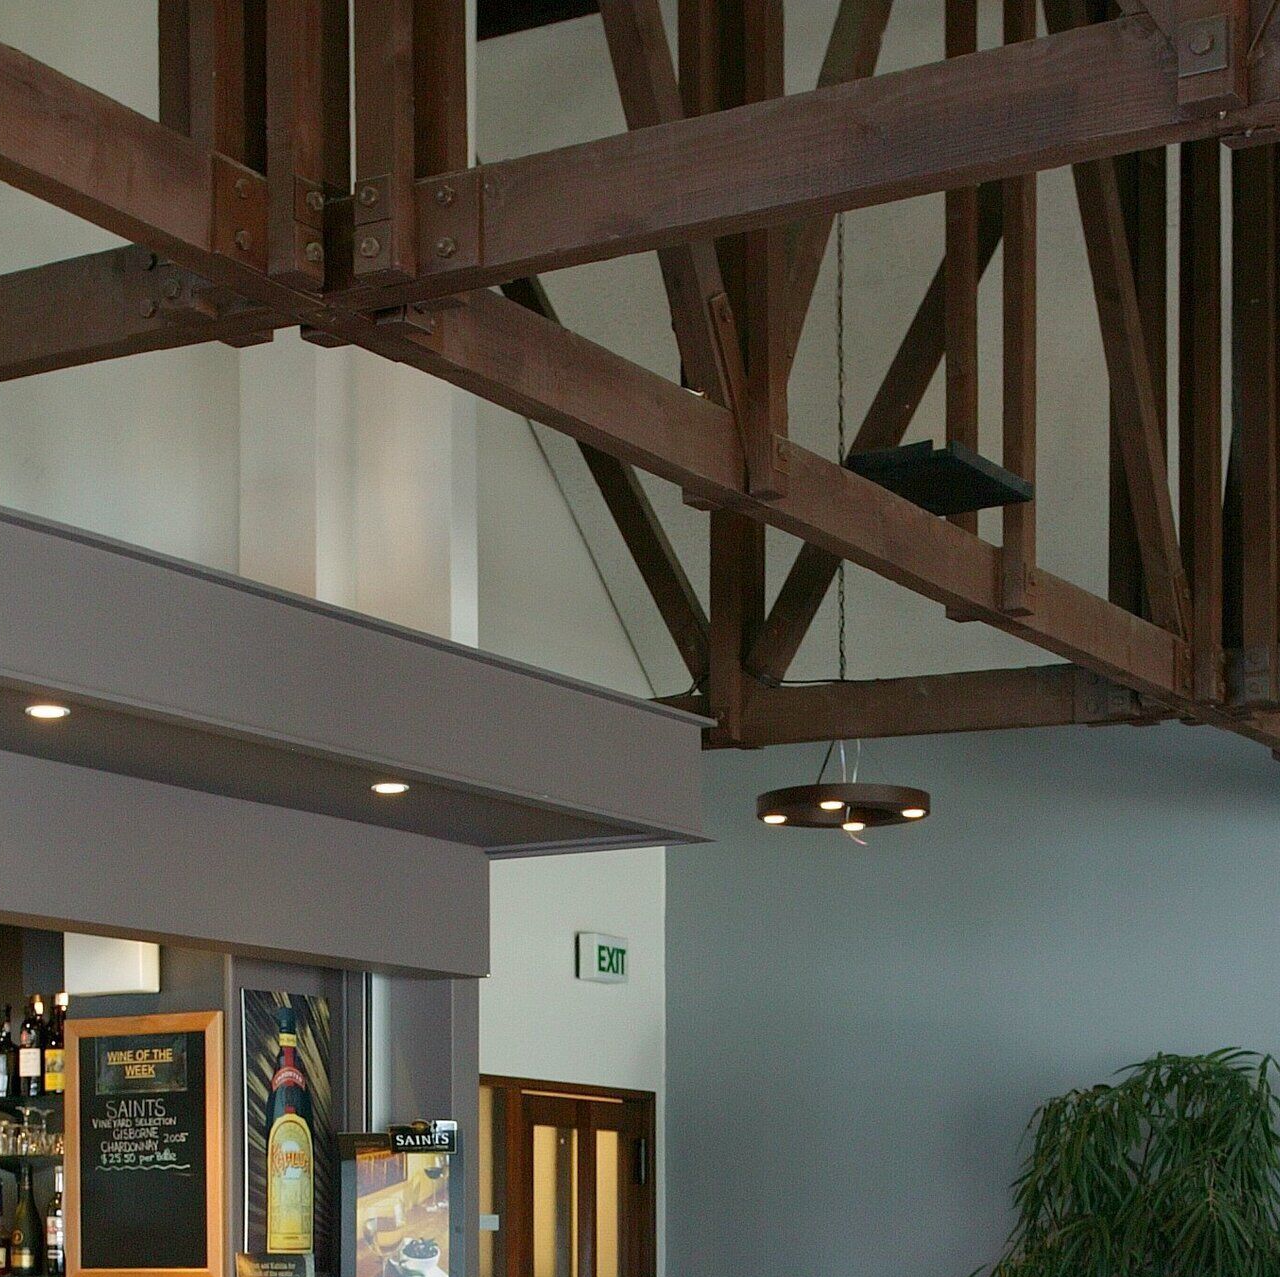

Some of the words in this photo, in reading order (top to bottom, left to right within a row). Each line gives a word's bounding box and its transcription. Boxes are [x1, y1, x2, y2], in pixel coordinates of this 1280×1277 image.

[598, 944, 626, 975] EXIT
[106, 1050, 134, 1063] WINE
[136, 1048, 150, 1061] OF
[152, 1047, 173, 1060] THE
[124, 1064, 156, 1077] WEEK
[105, 1098, 166, 1119] SAINTS
[92, 1118, 132, 1129] VINEYARD
[135, 1116, 177, 1127] SELECTION
[113, 1126, 159, 1140] GISBORNE
[163, 1132, 189, 1144] 2005
[395, 1132, 449, 1147] SAINTS
[100, 1139, 159, 1153] CHARDONNAY
